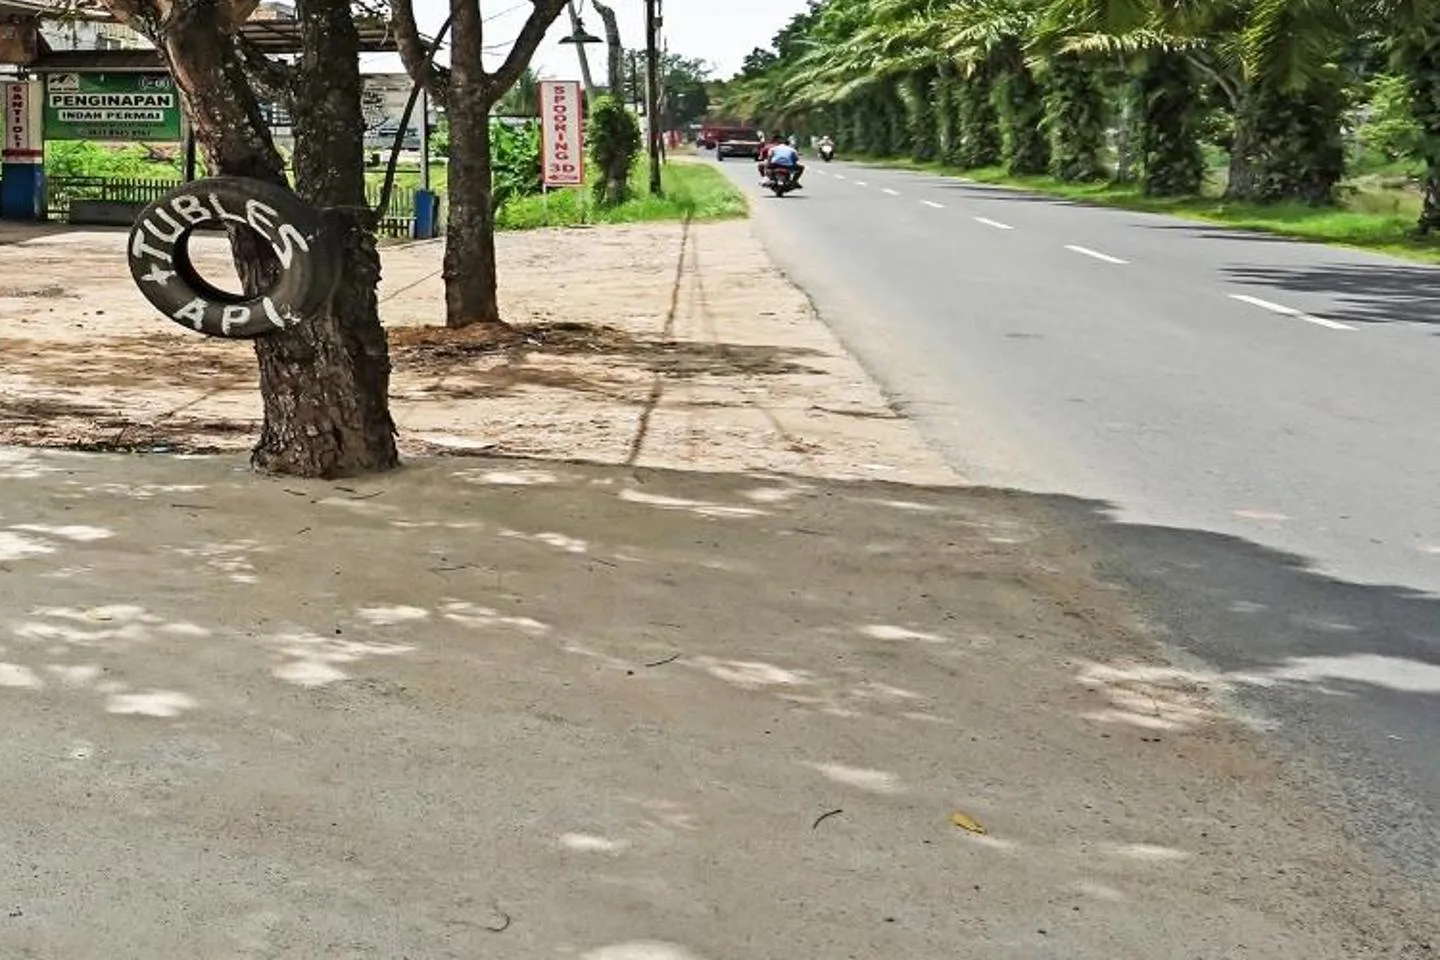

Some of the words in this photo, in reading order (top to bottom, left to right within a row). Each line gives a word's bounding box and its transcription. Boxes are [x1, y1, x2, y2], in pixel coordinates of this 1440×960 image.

[52, 95, 171, 107] PENGINAPAN
[62, 111, 103, 120] INDAH
[107, 111, 161, 120] PERMAI
[553, 85, 568, 161] SPOORING
[549, 163, 576, 173] 3D
[173, 297, 285, 336] API
